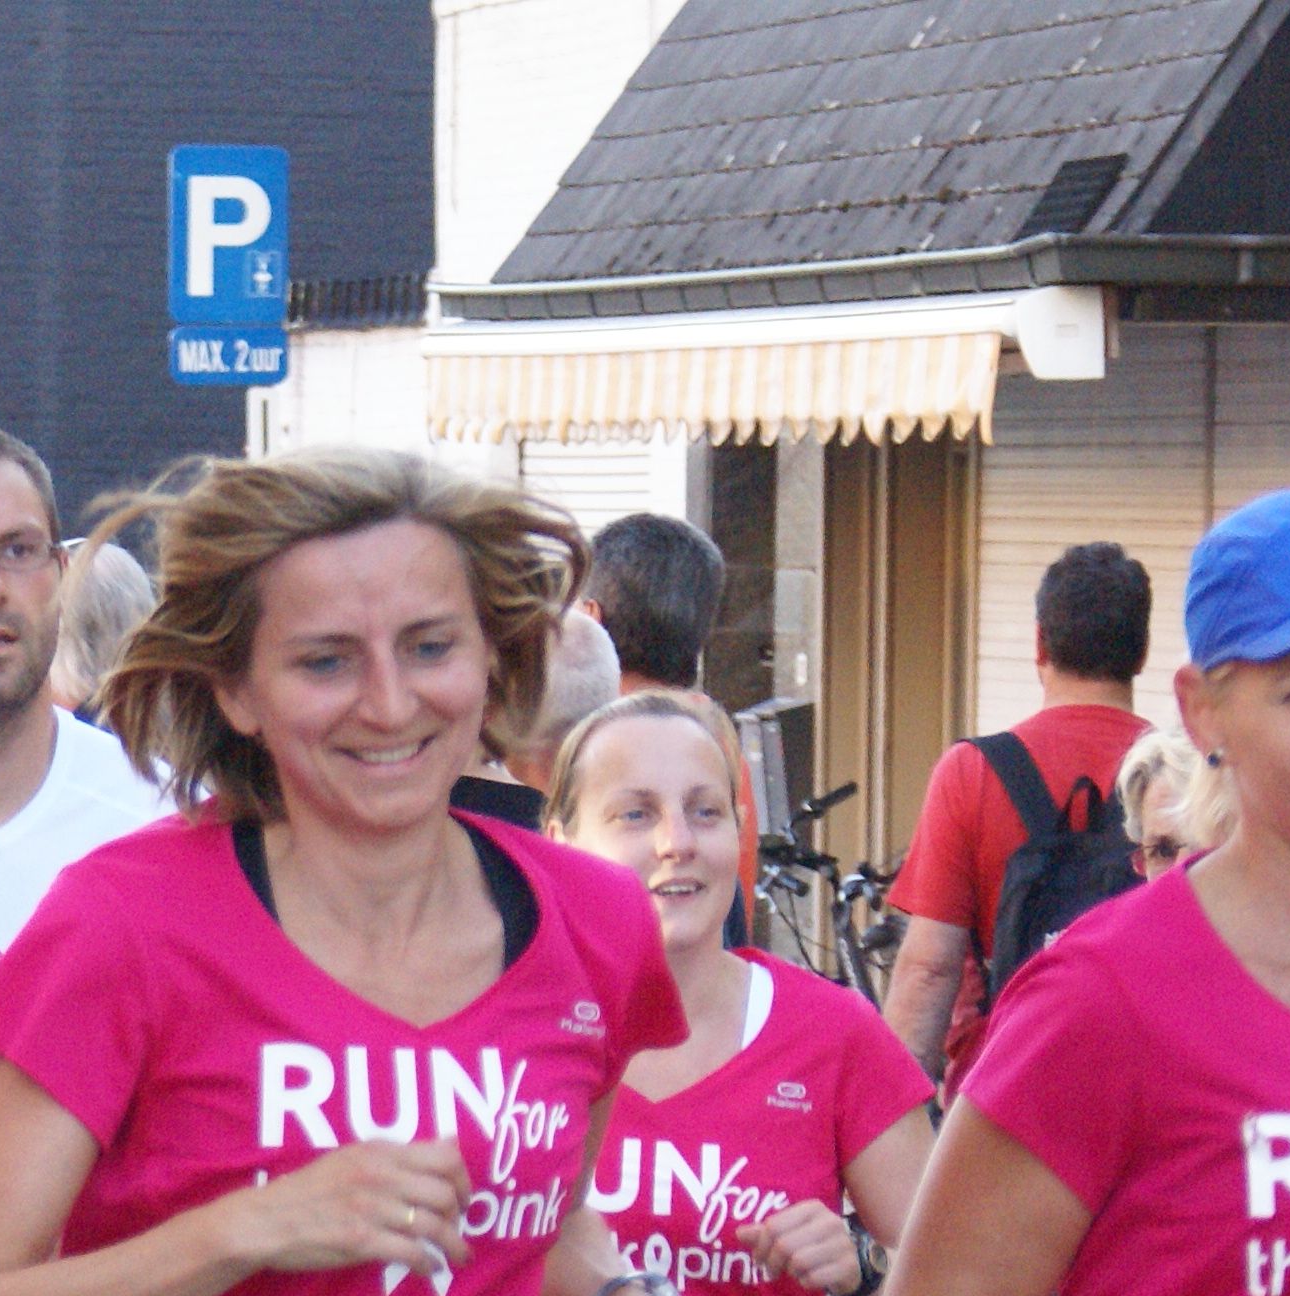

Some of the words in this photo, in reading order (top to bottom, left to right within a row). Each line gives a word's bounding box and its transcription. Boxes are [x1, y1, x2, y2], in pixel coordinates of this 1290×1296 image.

[186, 175, 271, 297] P
[260, 1042, 506, 1148] RUN
[490, 1059, 569, 1184] for
[698, 1156, 790, 1244] for
